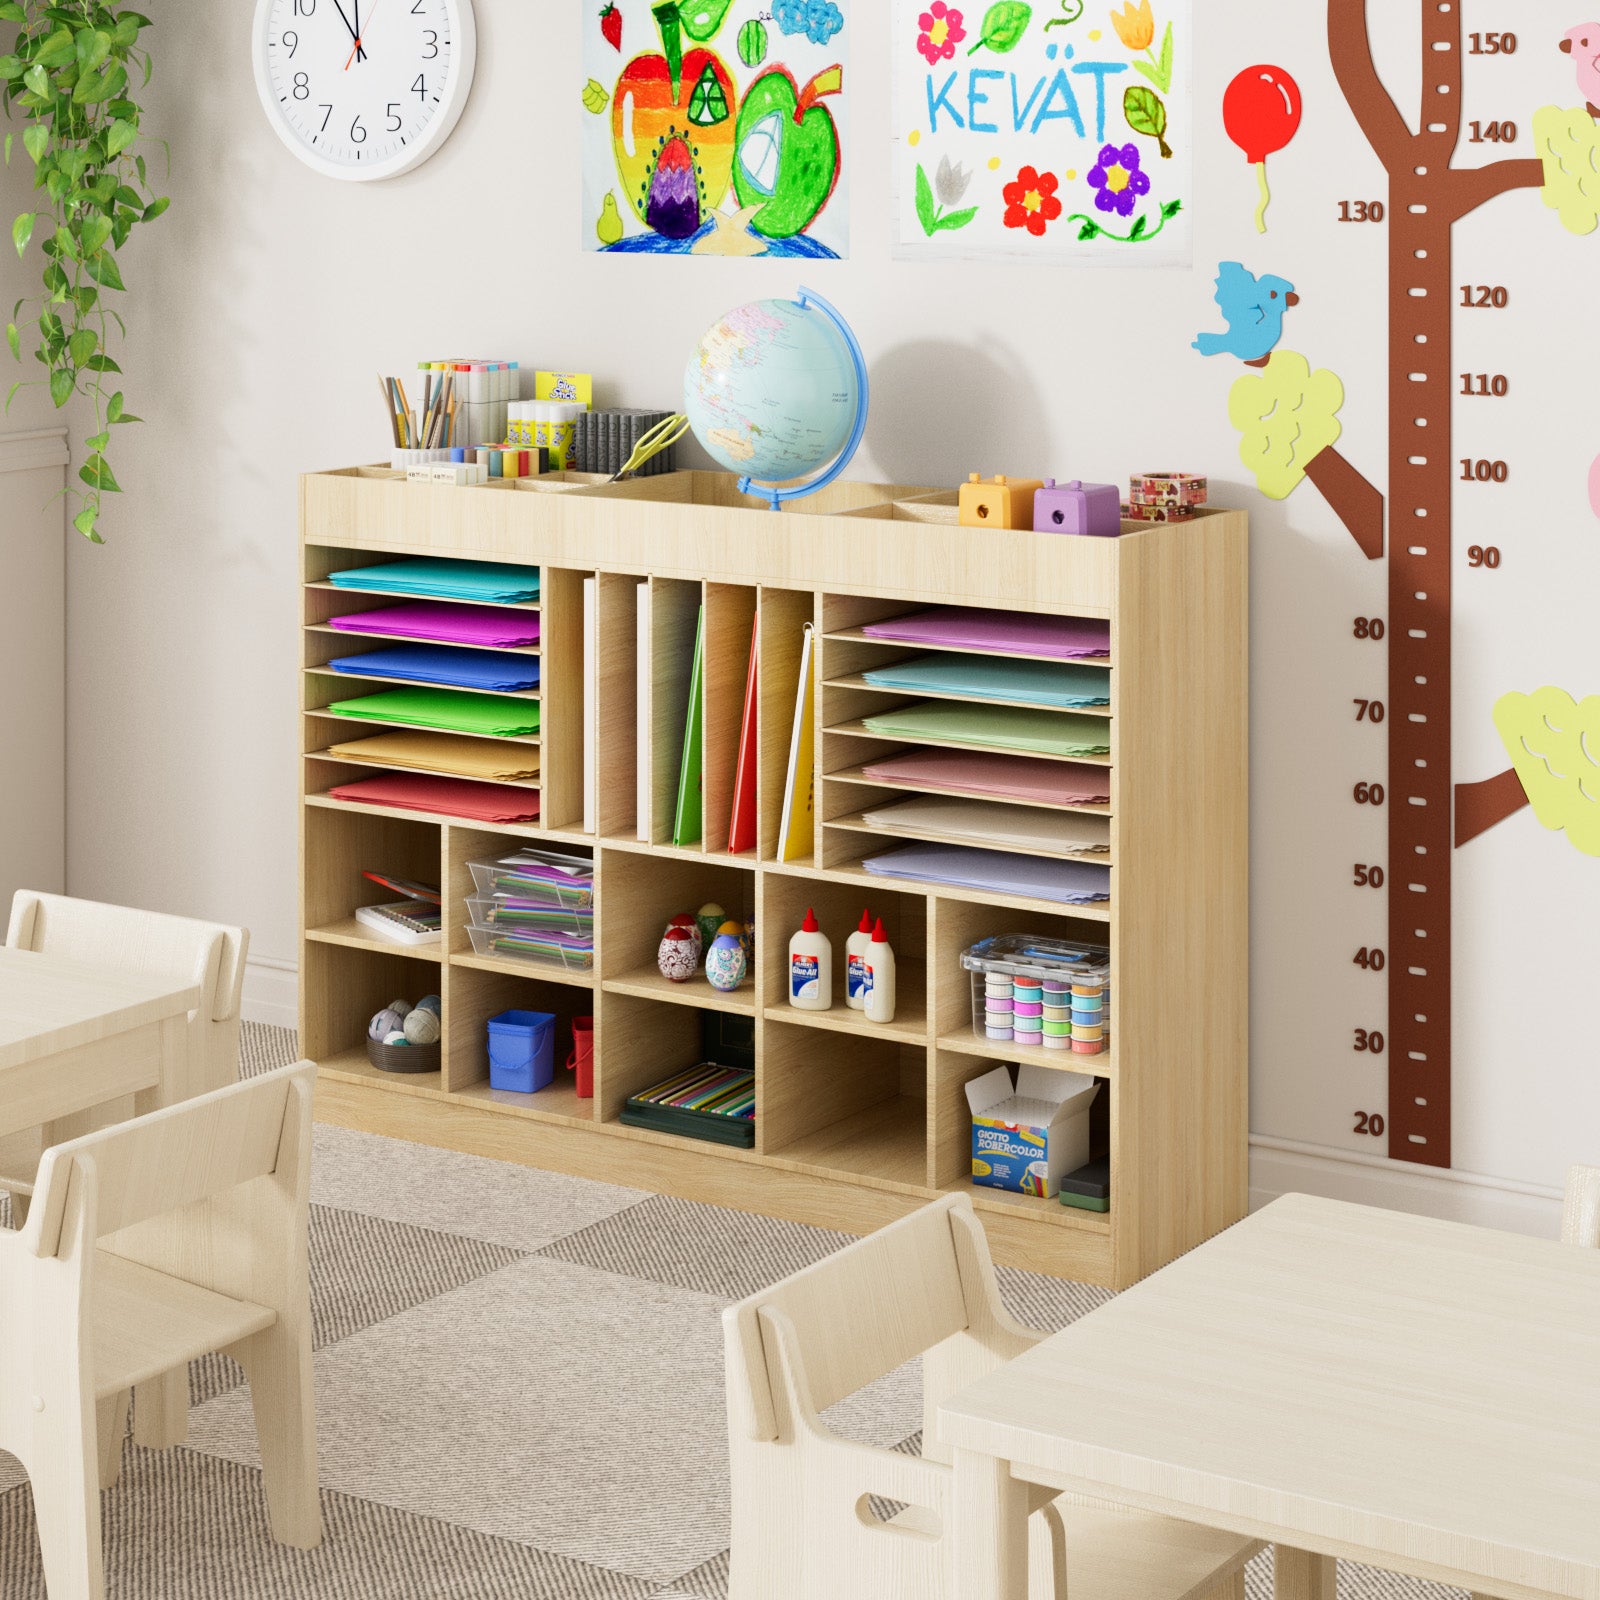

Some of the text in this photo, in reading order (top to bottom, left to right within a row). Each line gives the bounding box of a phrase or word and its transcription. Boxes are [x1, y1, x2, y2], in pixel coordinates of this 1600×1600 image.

[282, 30, 299, 59] 9
[421, 29, 438, 59] 3
[1470, 33, 1517, 55] 150
[292, 71, 310, 101] 8
[410, 73, 429, 102] 4
[926, 43, 1129, 143] KEVÄT
[318, 104, 333, 132] 7
[350, 114, 367, 143] 6
[386, 103, 402, 132] 5
[1470, 121, 1517, 143] 140
[1338, 201, 1384, 223] 130
[1461, 286, 1508, 308] 120
[550, 388, 577, 401] Stick
[557, 378, 577, 393] Glue
[1461, 374, 1508, 396] 110
[1461, 459, 1508, 482] 100
[1468, 545, 1500, 569] 90
[1353, 617, 1385, 641] 80
[1353, 699, 1385, 724] 70
[1353, 782, 1385, 806] 60
[1353, 864, 1385, 889] 50
[1353, 947, 1385, 972] 40
[1353, 1029, 1385, 1055] 30
[977, 1130, 1009, 1142] GIOTTO
[1353, 1111, 1385, 1137] 20
[978, 1139, 1044, 1159] ROBERCOLOR
